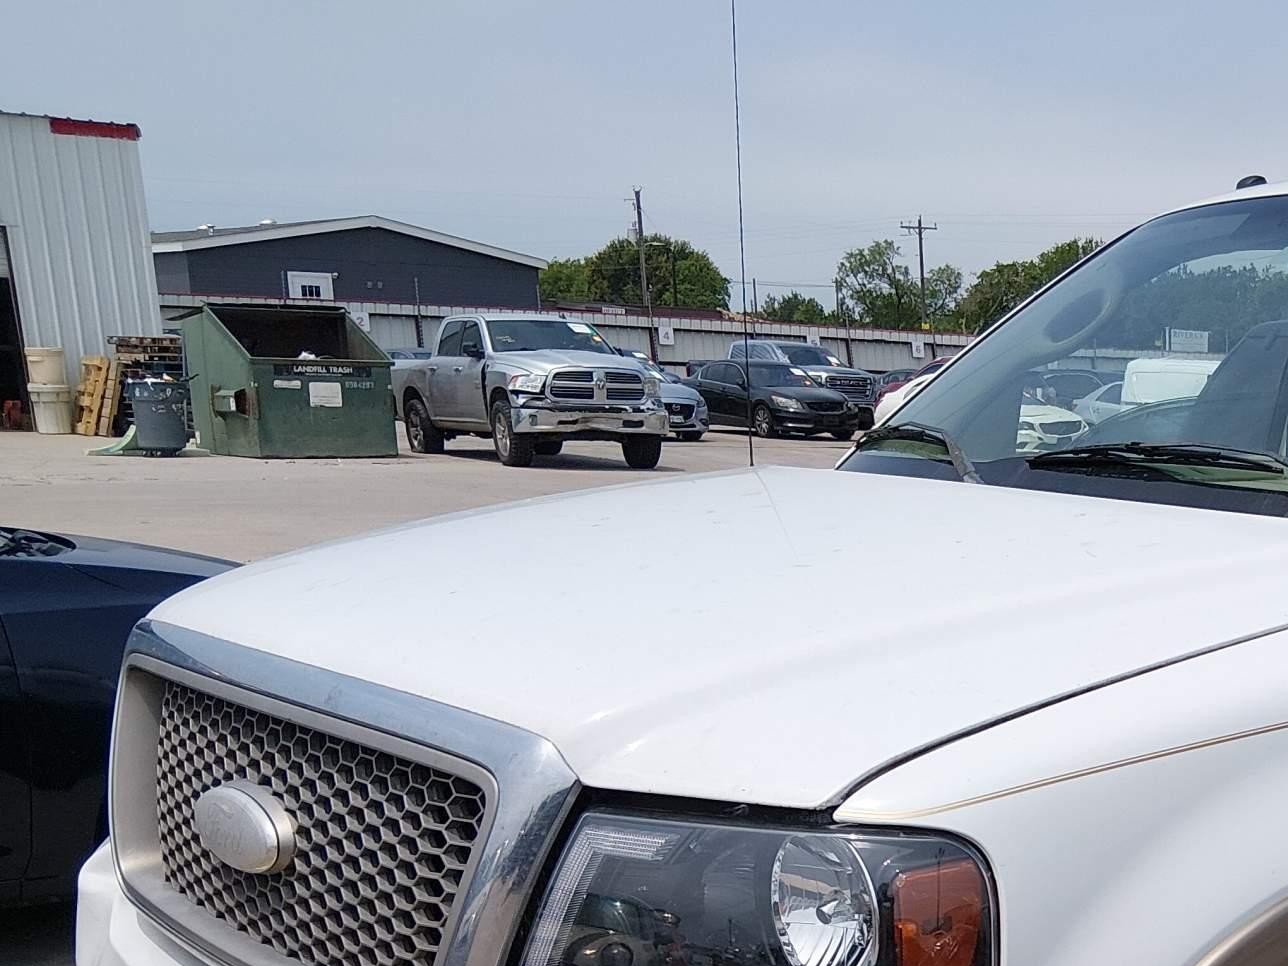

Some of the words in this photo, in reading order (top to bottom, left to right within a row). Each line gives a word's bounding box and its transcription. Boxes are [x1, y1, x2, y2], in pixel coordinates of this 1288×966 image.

[356, 316, 365, 327] 2
[663, 331, 670, 341] 4
[293, 365, 327, 373] LANDFILL
[329, 366, 352, 374] TRASH
